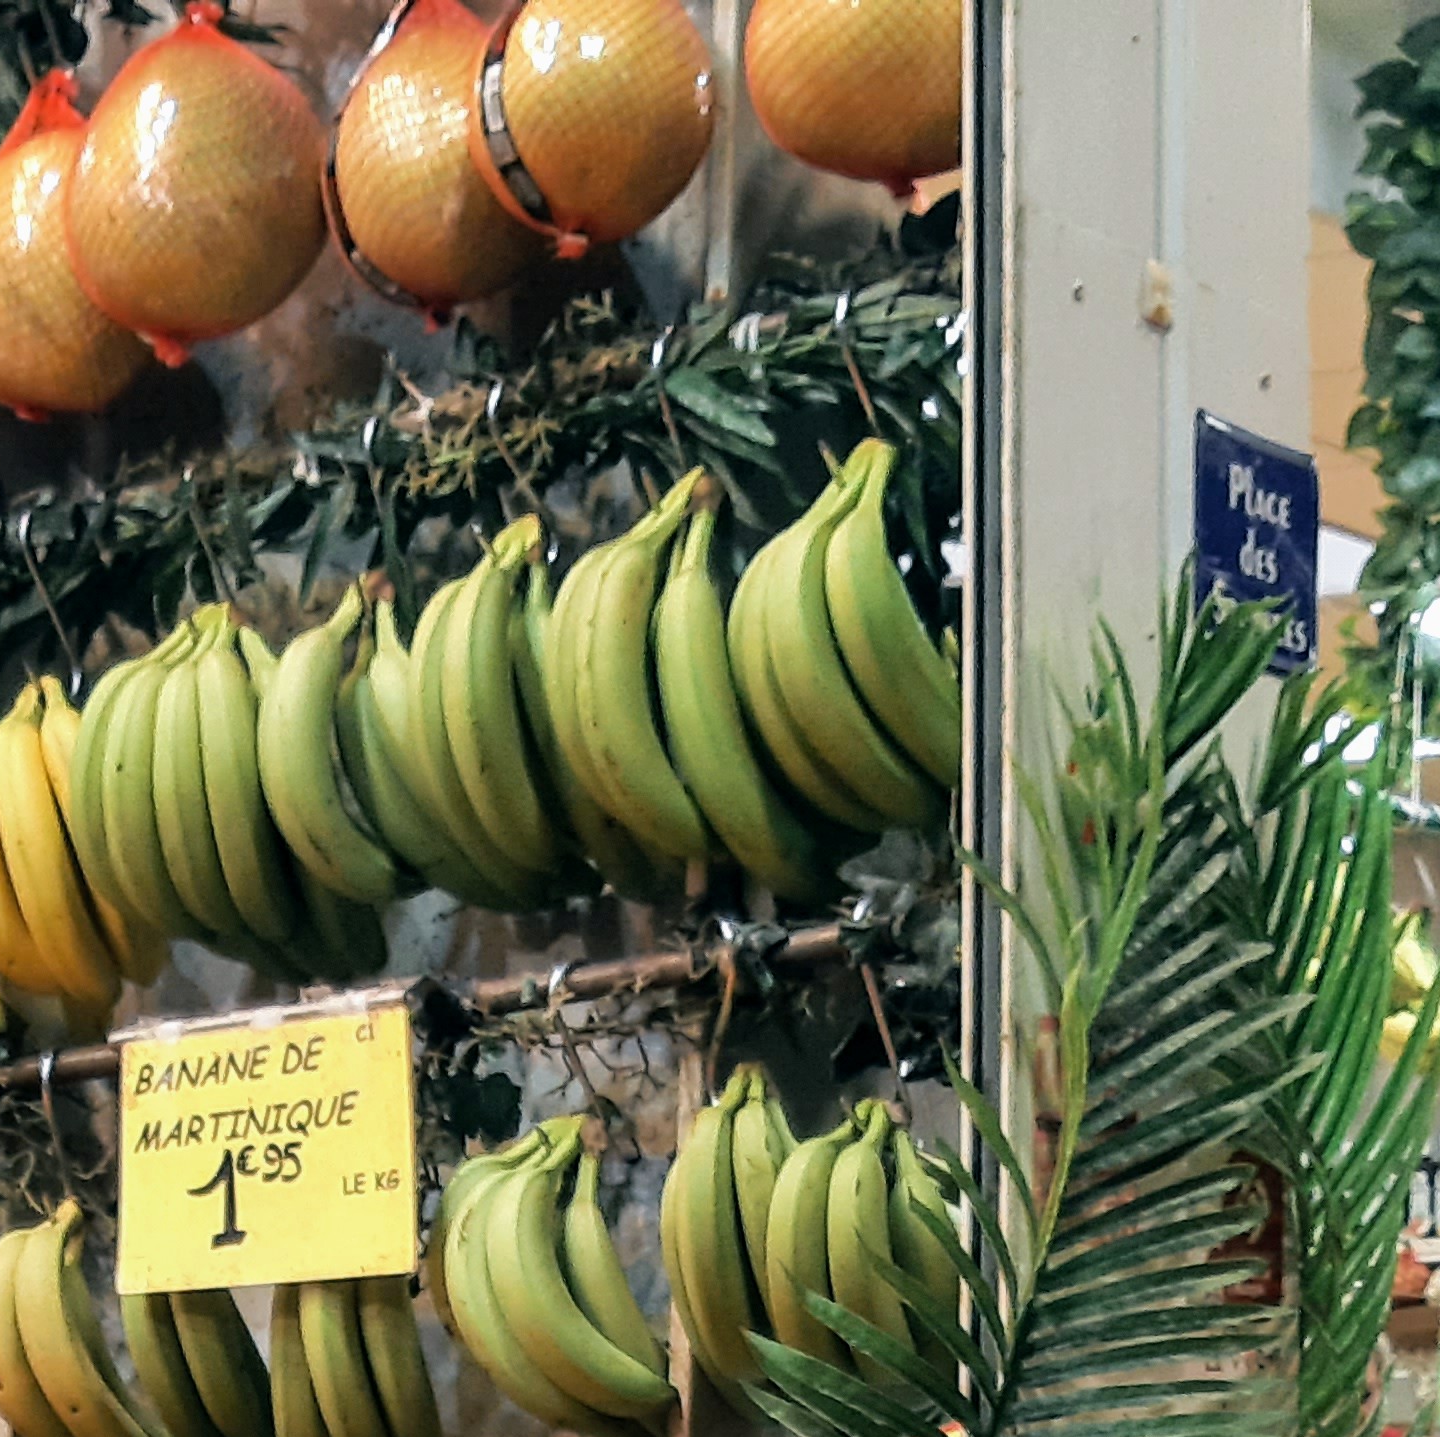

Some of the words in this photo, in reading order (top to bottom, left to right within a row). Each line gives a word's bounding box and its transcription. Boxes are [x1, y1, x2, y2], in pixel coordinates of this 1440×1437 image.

[134, 1045, 270, 1096] BANANE
[281, 1036, 325, 1074] DE
[134, 1090, 359, 1153] MARTINIQUE
[343, 1175, 366, 1195] LE
[374, 1169, 400, 1191] KG
